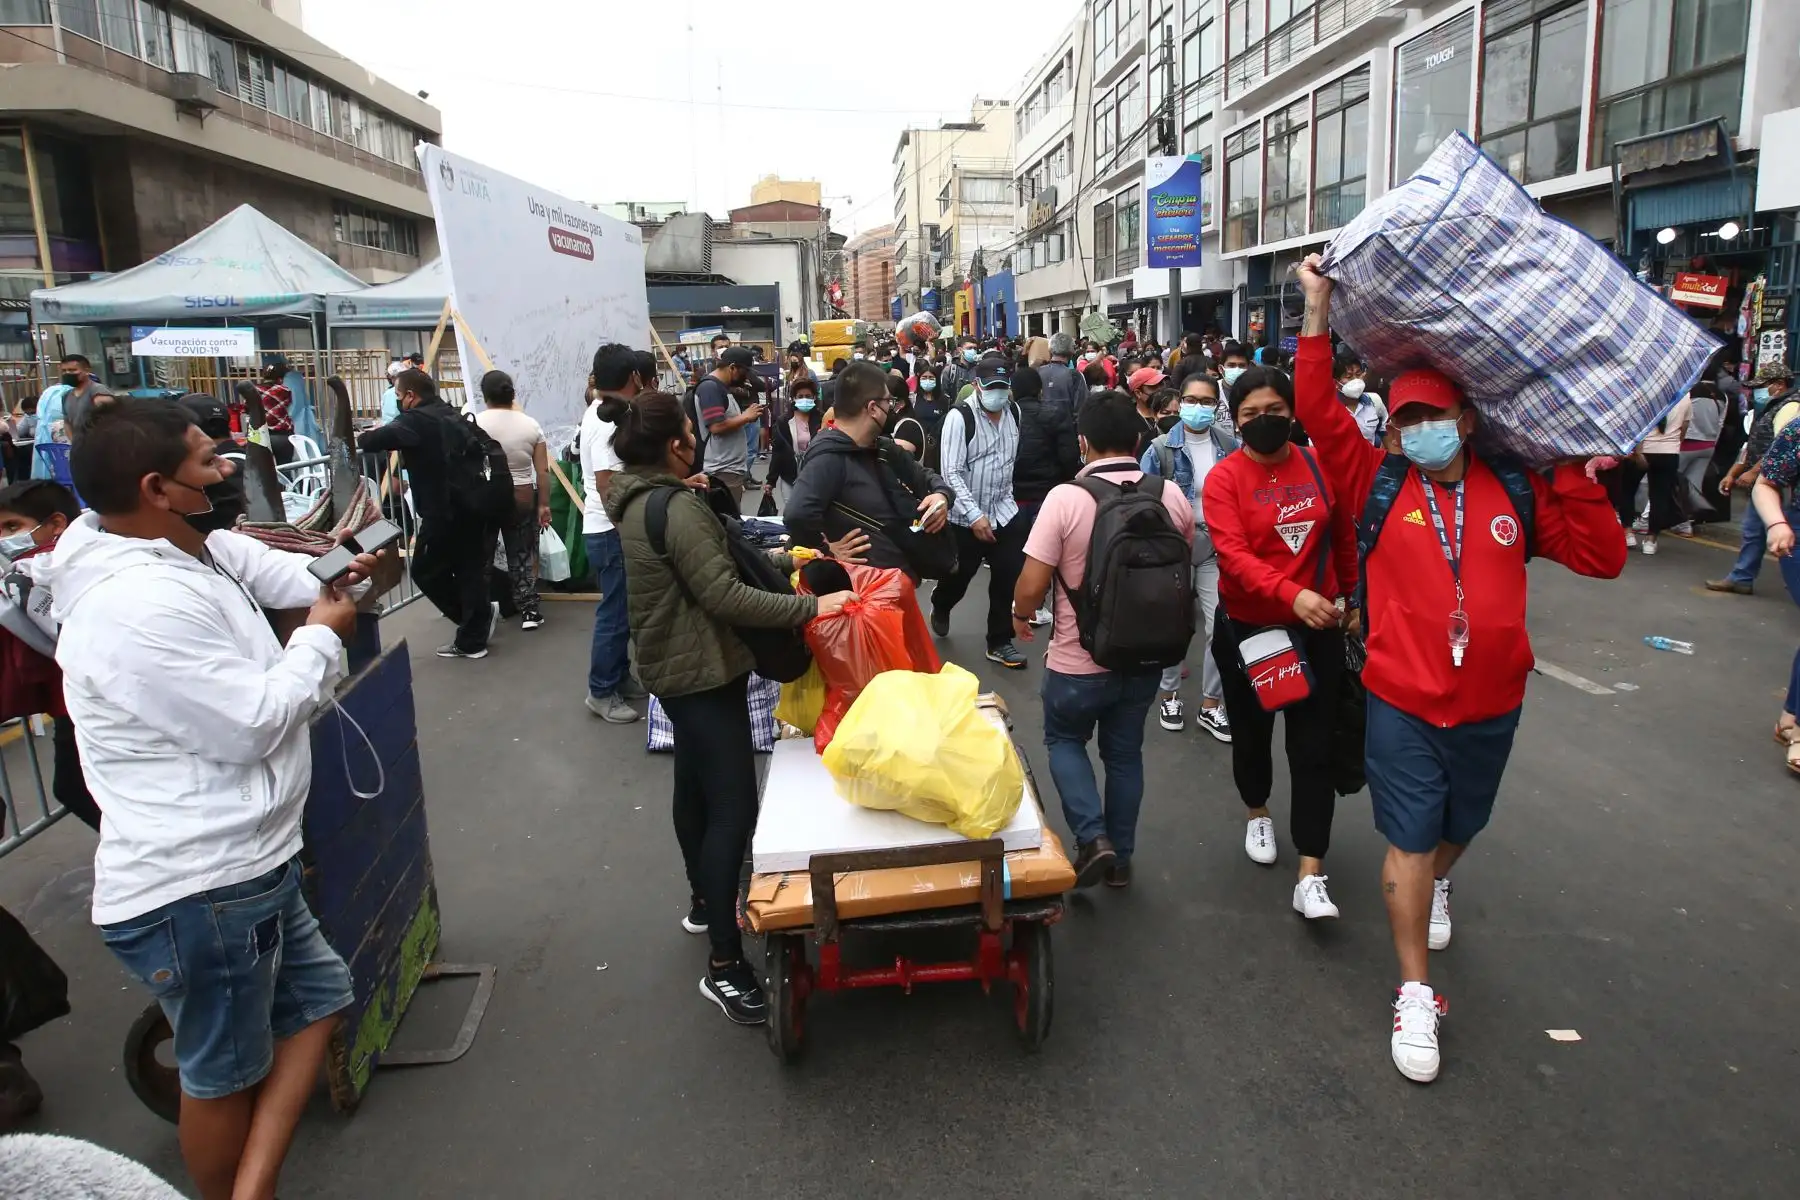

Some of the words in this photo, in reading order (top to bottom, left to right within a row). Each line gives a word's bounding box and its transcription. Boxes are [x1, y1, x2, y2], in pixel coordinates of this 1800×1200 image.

[1425, 46, 1455, 69] TOUGH
[460, 177, 492, 204] LIMA
[527, 196, 545, 218] Una
[545, 206, 551, 225] y
[551, 206, 564, 225] mil
[564, 213, 589, 233] razones
[589, 222, 603, 238] para
[1153, 242, 1197, 252] mascarilla
[185, 295, 239, 308] SISOL
[150, 337, 207, 346] Vacunación
[209, 338, 238, 346] contra
[174, 346, 220, 354] COVID-19
[1254, 482, 1318, 506] GUESS
[1276, 497, 1317, 523] jeans
[1402, 515, 1426, 527] adidas
[1280, 524, 1309, 535] GUESS
